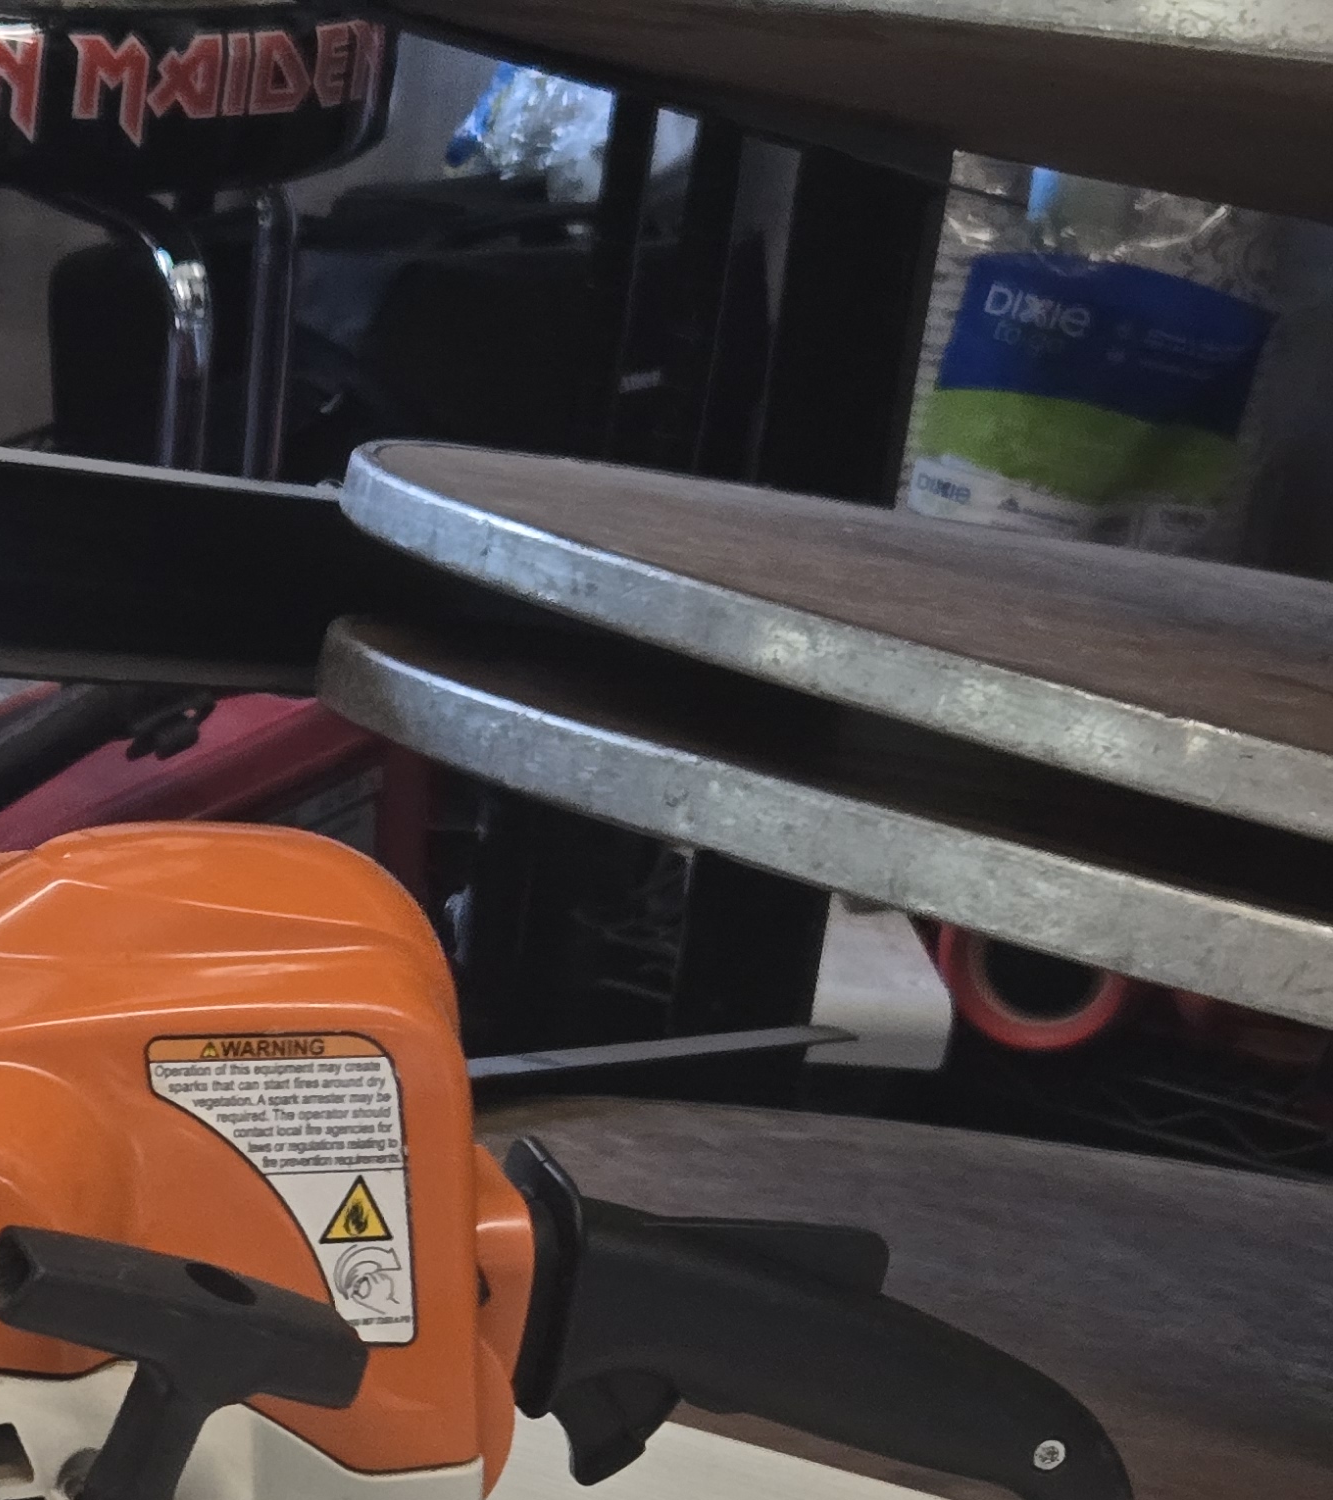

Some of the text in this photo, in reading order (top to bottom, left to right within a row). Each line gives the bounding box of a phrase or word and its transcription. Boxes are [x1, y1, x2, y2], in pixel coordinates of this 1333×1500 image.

[68, 19, 385, 149] MAIDEN
[220, 1038, 325, 1057] WARNING
[154, 1062, 380, 1079] Operation of this equipment may create
[168, 1077, 385, 1094] sparks that can start fires around dry
[257, 1094, 266, 1105] A
[268, 1094, 299, 1106] spark
[349, 1094, 373, 1105] may
[375, 1092, 392, 1102] be
[216, 1107, 391, 1123] required. The operator should
[233, 1126, 274, 1138] contact
[276, 1124, 302, 1136] local
[377, 1122, 393, 1133] for
